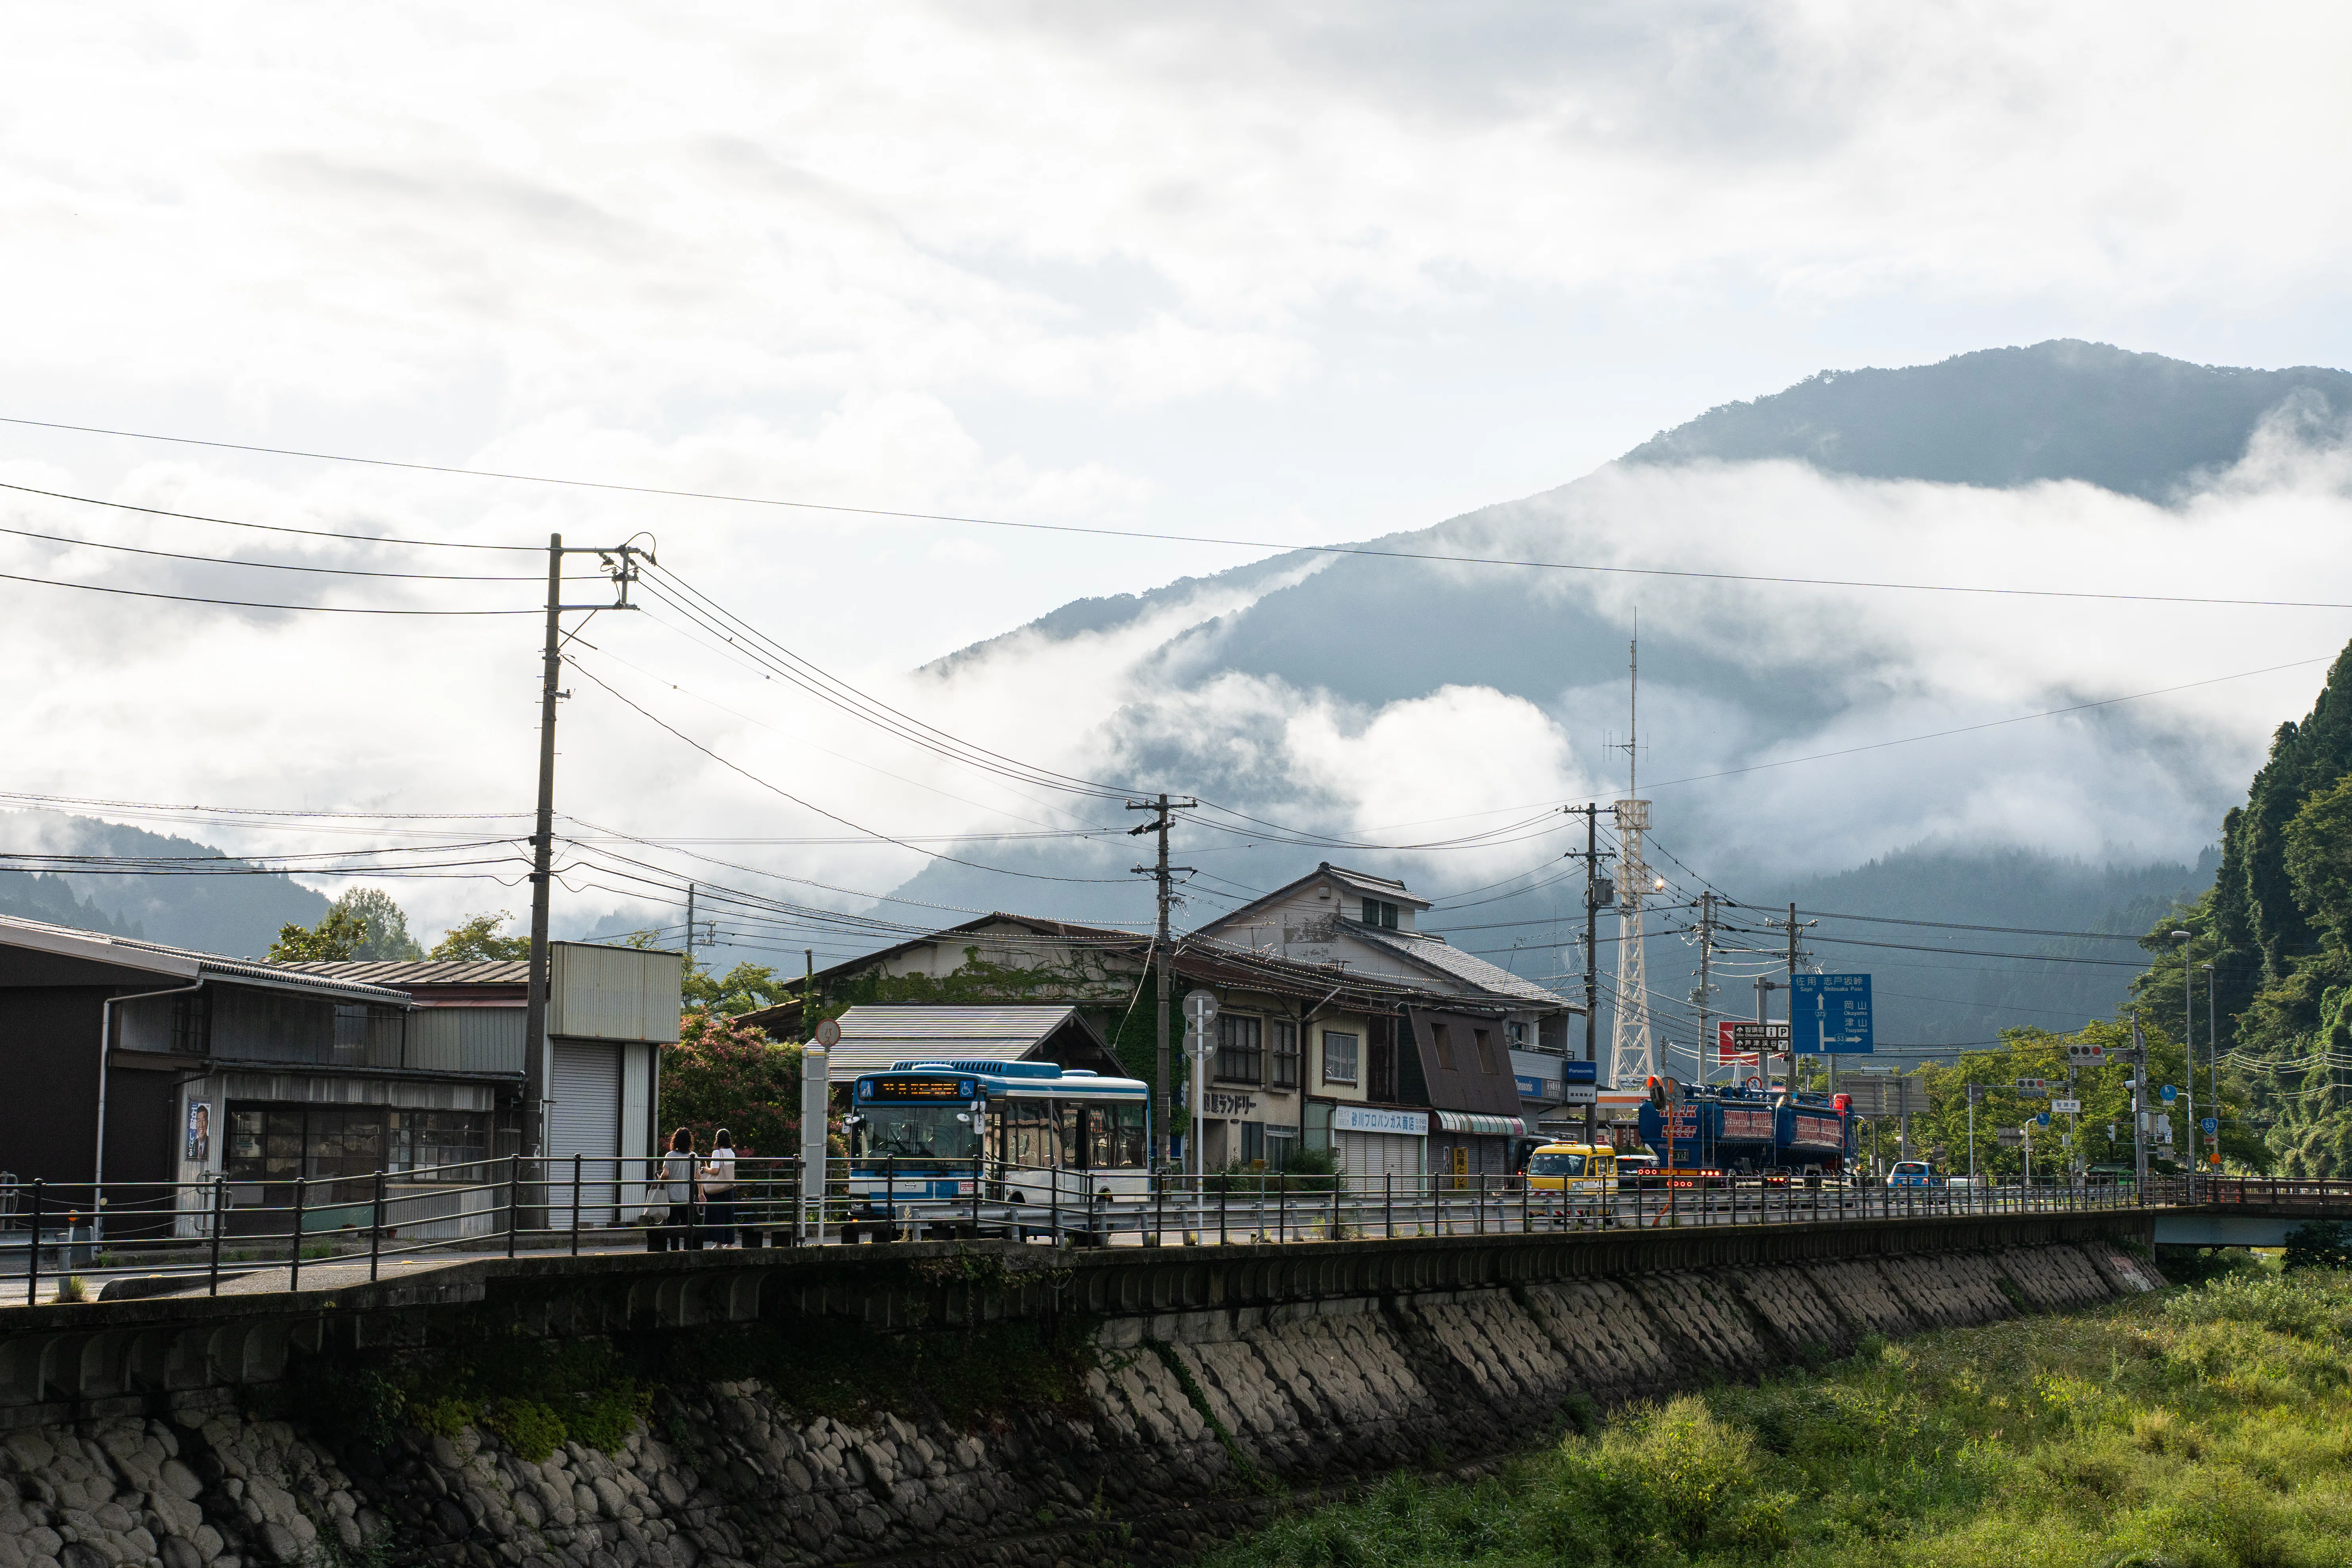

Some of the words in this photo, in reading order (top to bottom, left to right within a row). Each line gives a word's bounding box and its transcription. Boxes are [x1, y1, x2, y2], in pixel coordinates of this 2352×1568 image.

[1796, 977, 1816, 986] 佐用
[1824, 977, 1863, 986] 志戸坂峠
[1845, 1001, 1866, 1009] 岡山
[1845, 1018, 1867, 1027] 津山
